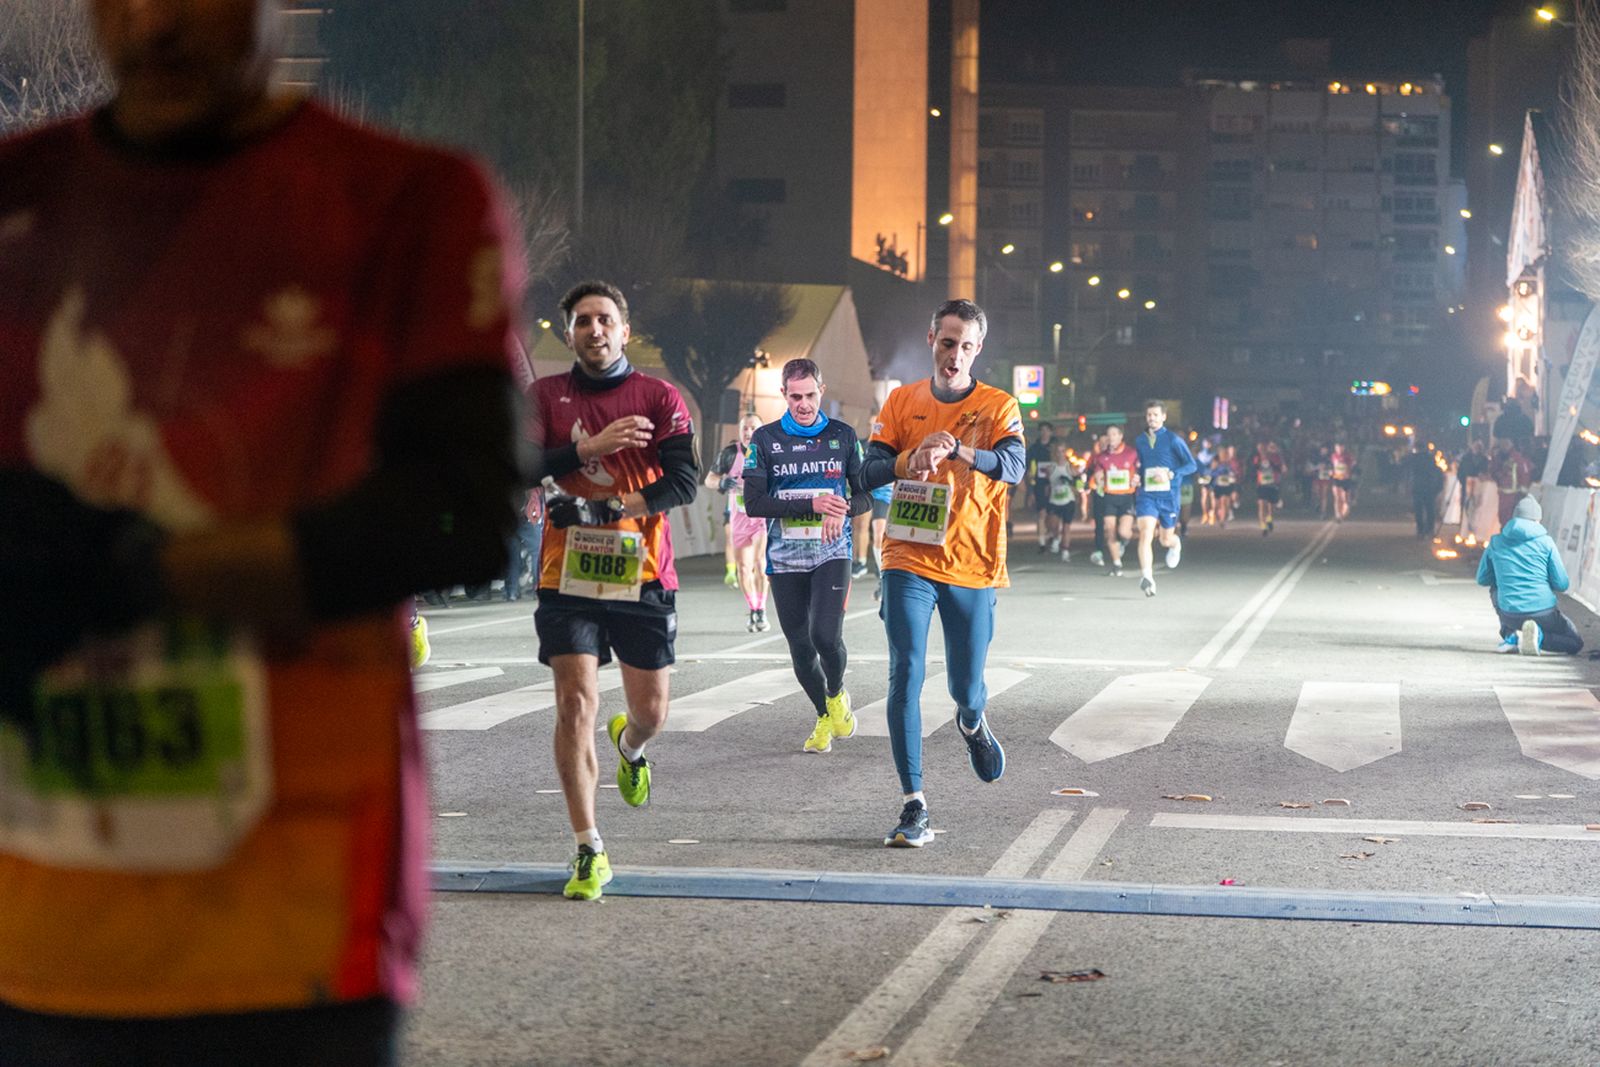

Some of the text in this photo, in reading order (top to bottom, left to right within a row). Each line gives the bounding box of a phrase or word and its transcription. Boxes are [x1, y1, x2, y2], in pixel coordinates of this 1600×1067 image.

[773, 457, 842, 477] SAN ANTÓN
[896, 501, 938, 523] 12278
[574, 542, 588, 550] SAN
[580, 553, 626, 576] 6188
